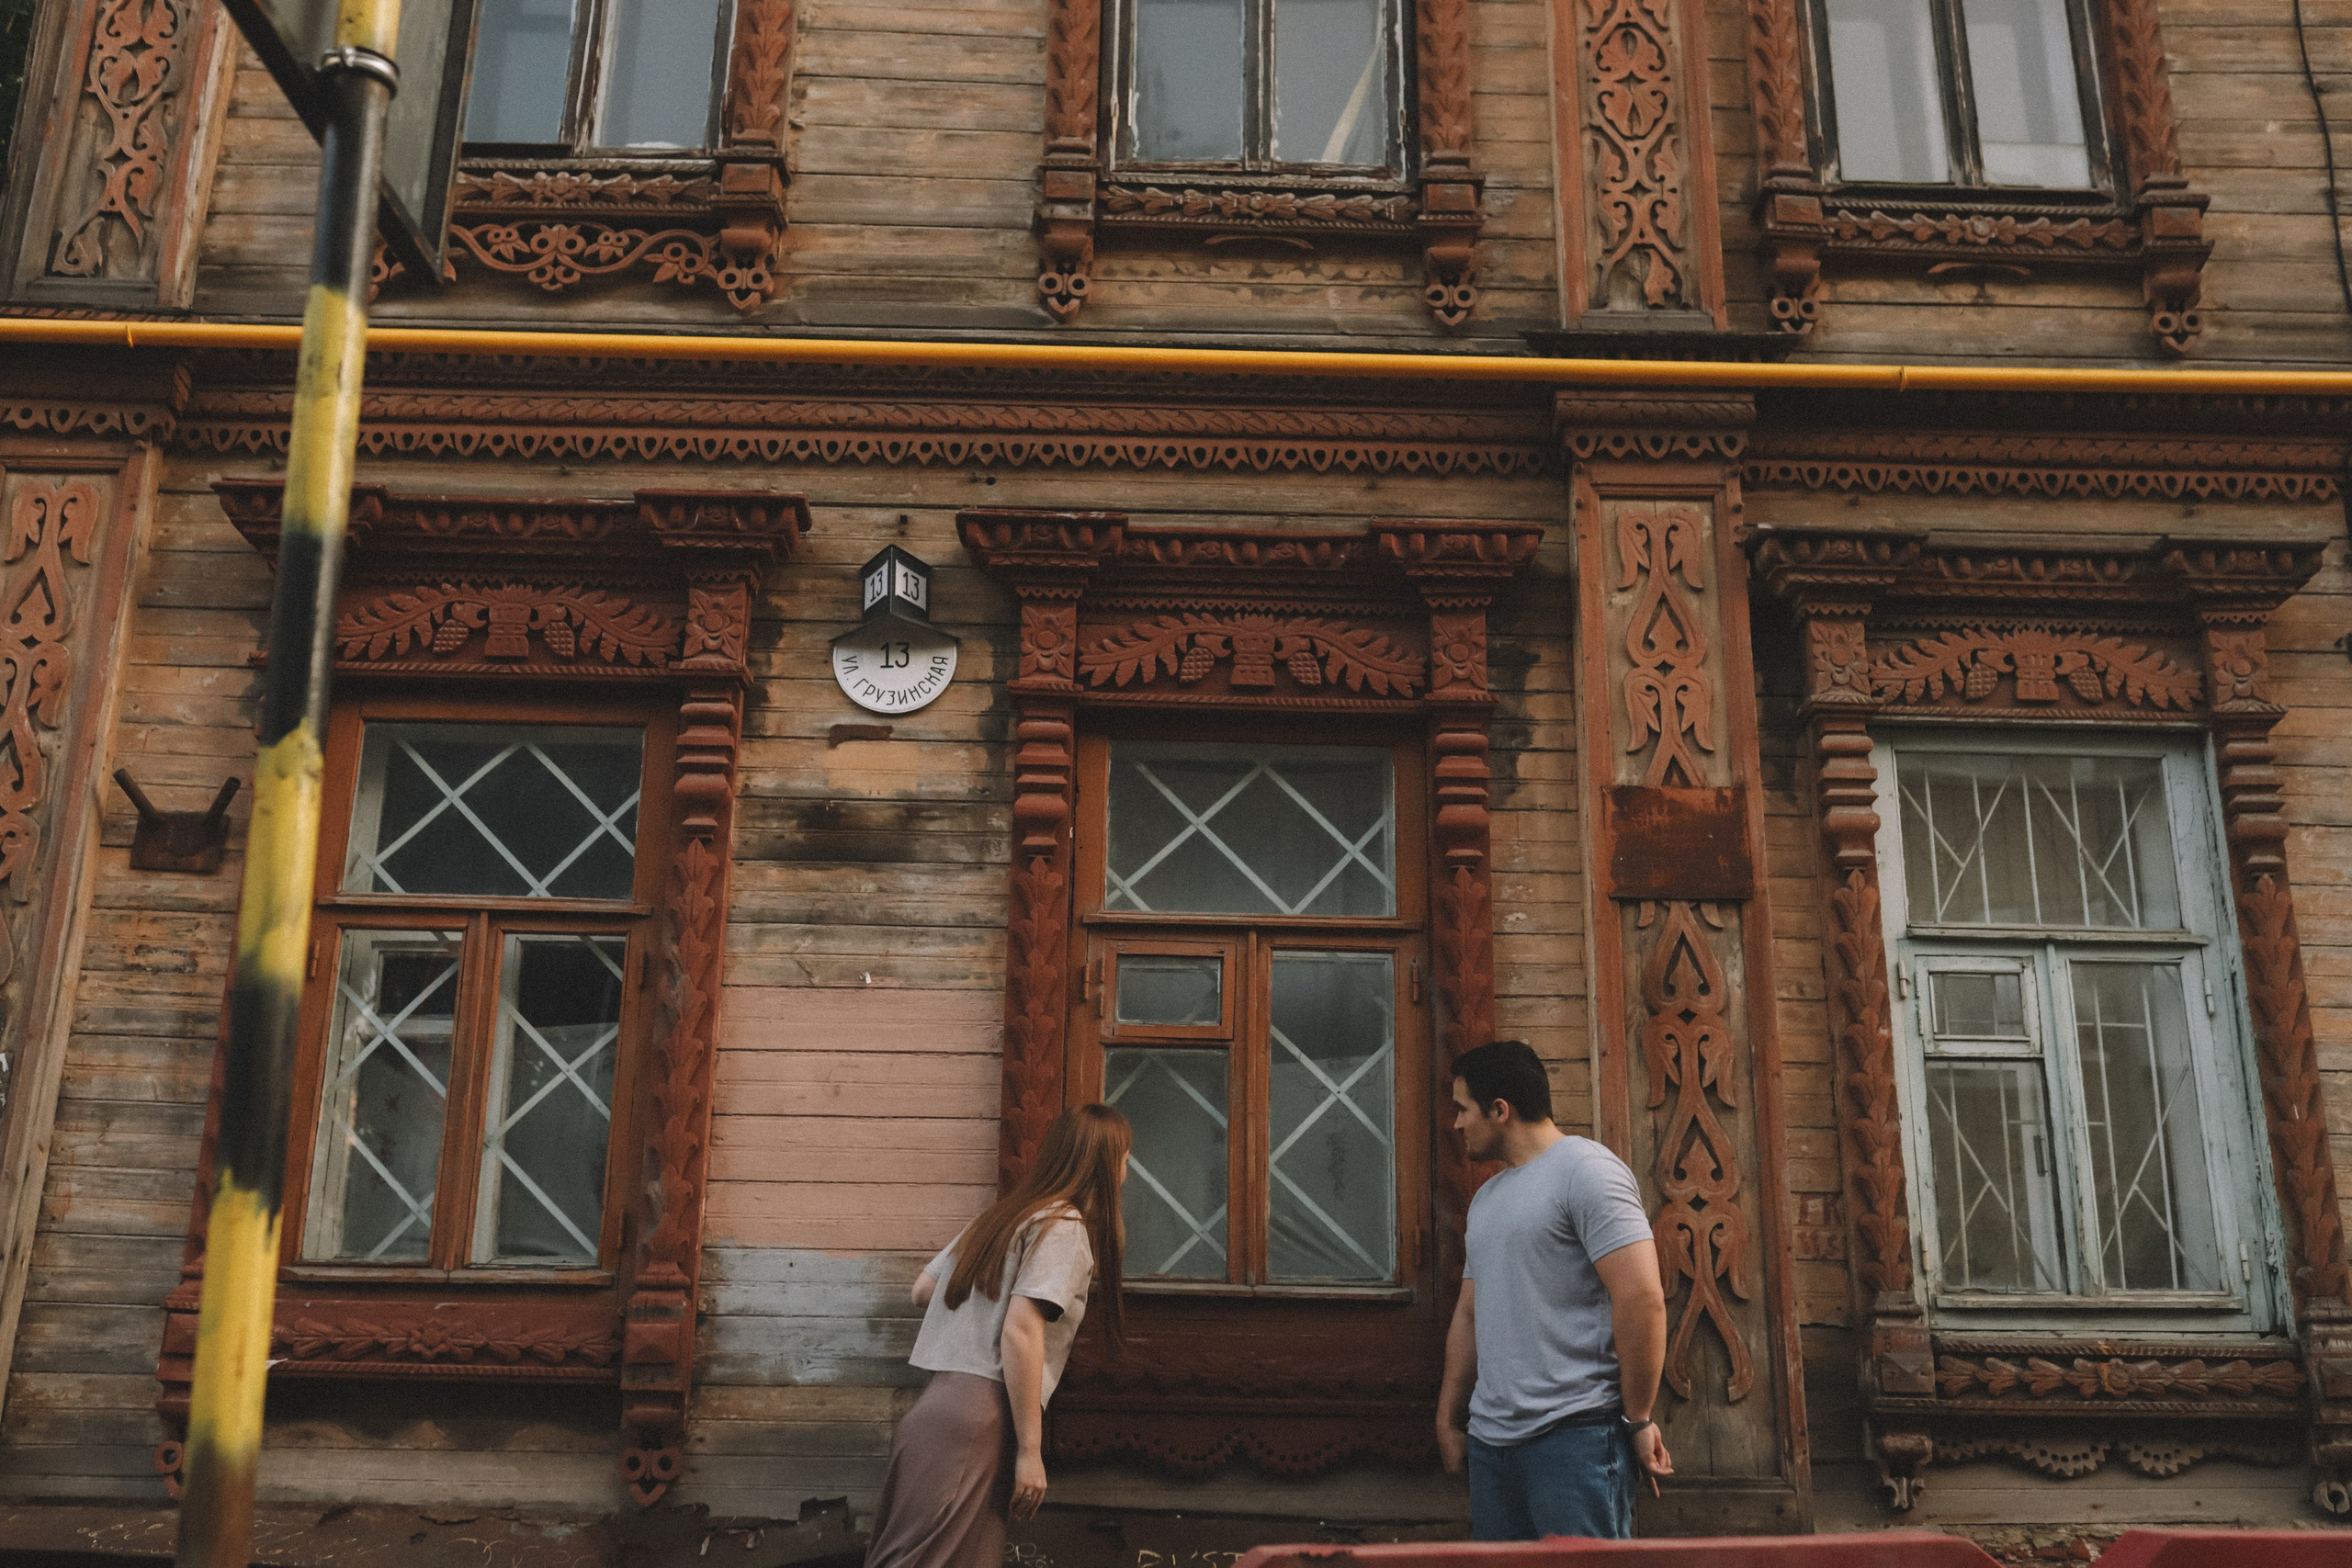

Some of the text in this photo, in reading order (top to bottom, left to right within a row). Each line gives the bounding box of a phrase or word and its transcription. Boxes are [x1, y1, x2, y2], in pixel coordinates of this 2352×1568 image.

[869, 570, 884, 603] 13
[902, 571, 920, 602] 13
[879, 642, 910, 669] 13
[853, 656, 949, 705] ГРУЗИНСКАЯ
